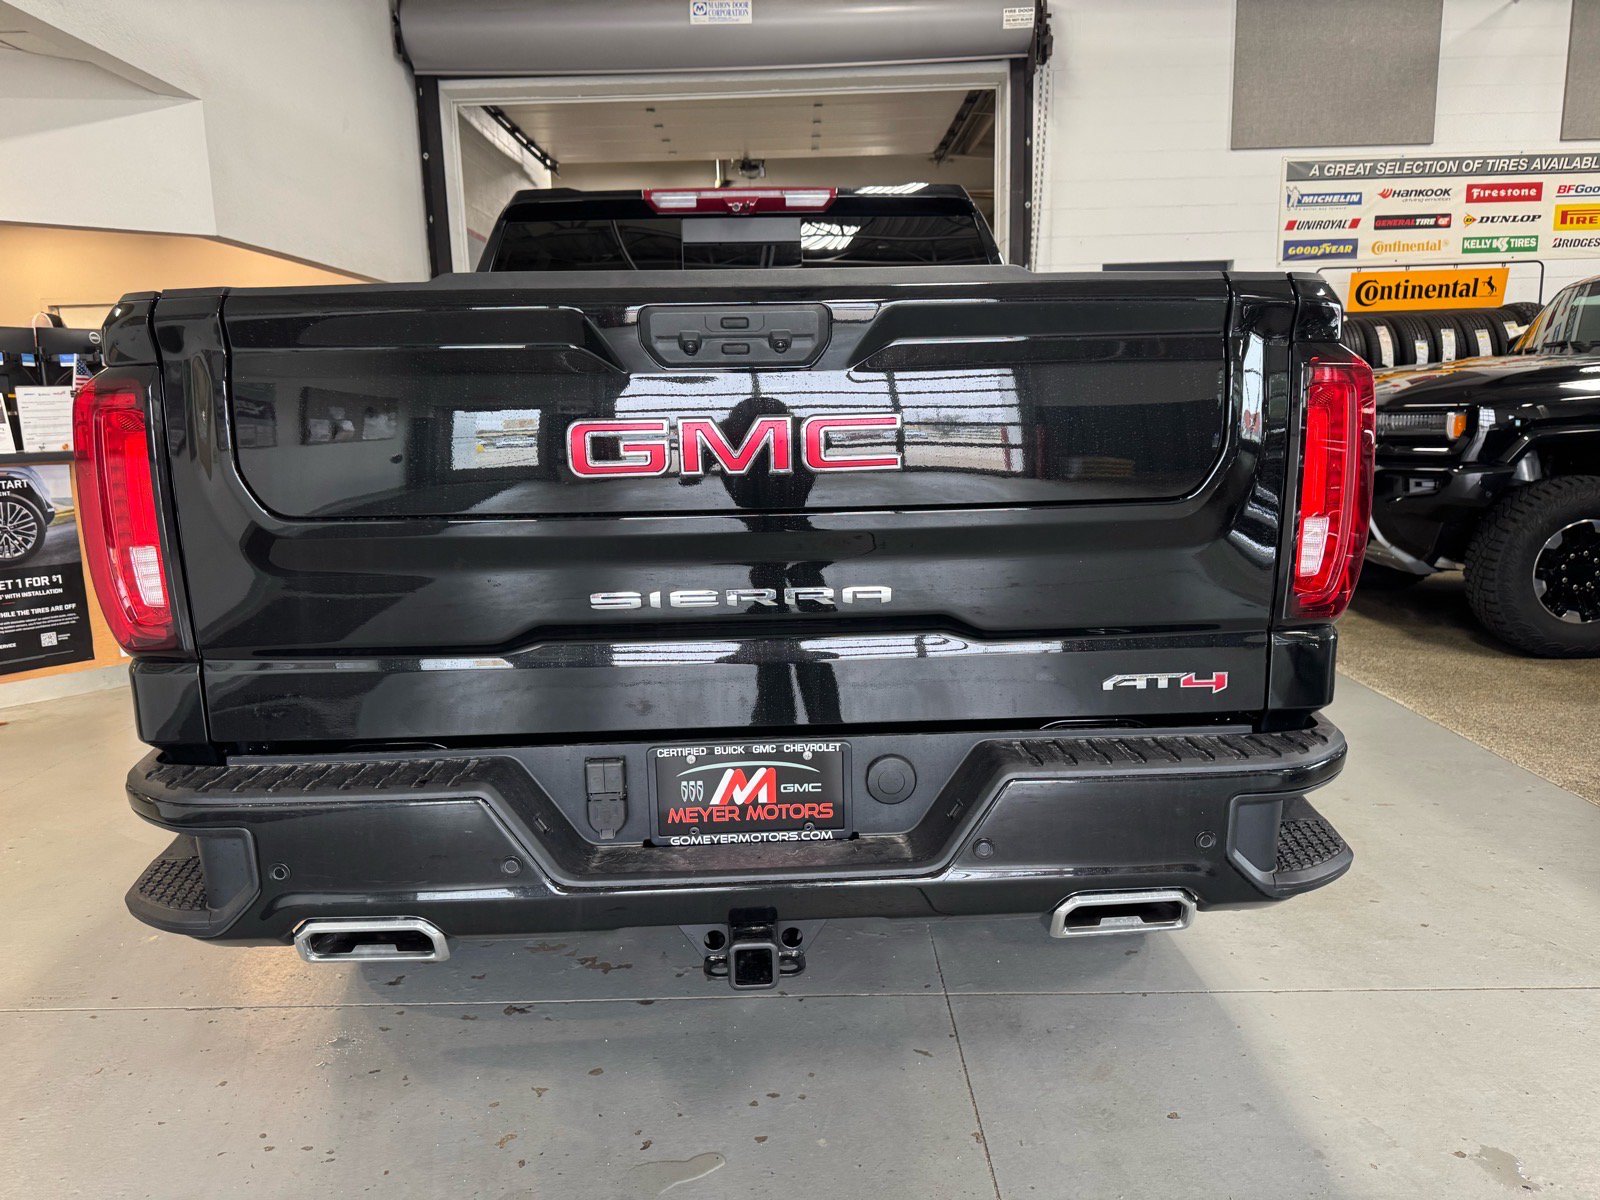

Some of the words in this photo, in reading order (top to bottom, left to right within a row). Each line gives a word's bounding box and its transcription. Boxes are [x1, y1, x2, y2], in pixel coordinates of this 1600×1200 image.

[1309, 165, 1320, 177] A
[1324, 163, 1373, 176] GREAT
[1375, 160, 1459, 175] SELECTION
[1462, 160, 1483, 173] OF
[1486, 158, 1529, 172] TIRES
[1302, 193, 1360, 204] MICHELIN
[1471, 188, 1537, 199] Firestone
[1296, 219, 1347, 230] UNIROYAL
[1375, 218, 1416, 227] GENERAL
[1415, 218, 1436, 226] TIRE
[1478, 215, 1541, 224] DUNLOP
[1287, 243, 1353, 256] GOODYEAR
[1371, 240, 1442, 255] Continental
[1464, 239, 1491, 249] KELLY
[1510, 237, 1537, 248] TIRES
[1355, 277, 1479, 307] Continental
[566, 413, 902, 478] GMC
[15, 579, 23, 589] 1
[25, 576, 50, 588] FOR
[52, 574, 63, 584] $1
[21, 588, 63, 598] INSTALLATION
[589, 586, 893, 610] SIERRA
[1102, 671, 1229, 694] AT4
[656, 747, 707, 758] CERTIFIED
[714, 746, 745, 755] BUICK
[752, 744, 777, 754] GMC
[783, 743, 842, 753] CHEVROLET
[780, 783, 822, 793] GMC
[667, 805, 741, 824] MEYER
[746, 802, 834, 821] MOTORS
[670, 830, 834, 846] GOMEYERMOTORS.COM
